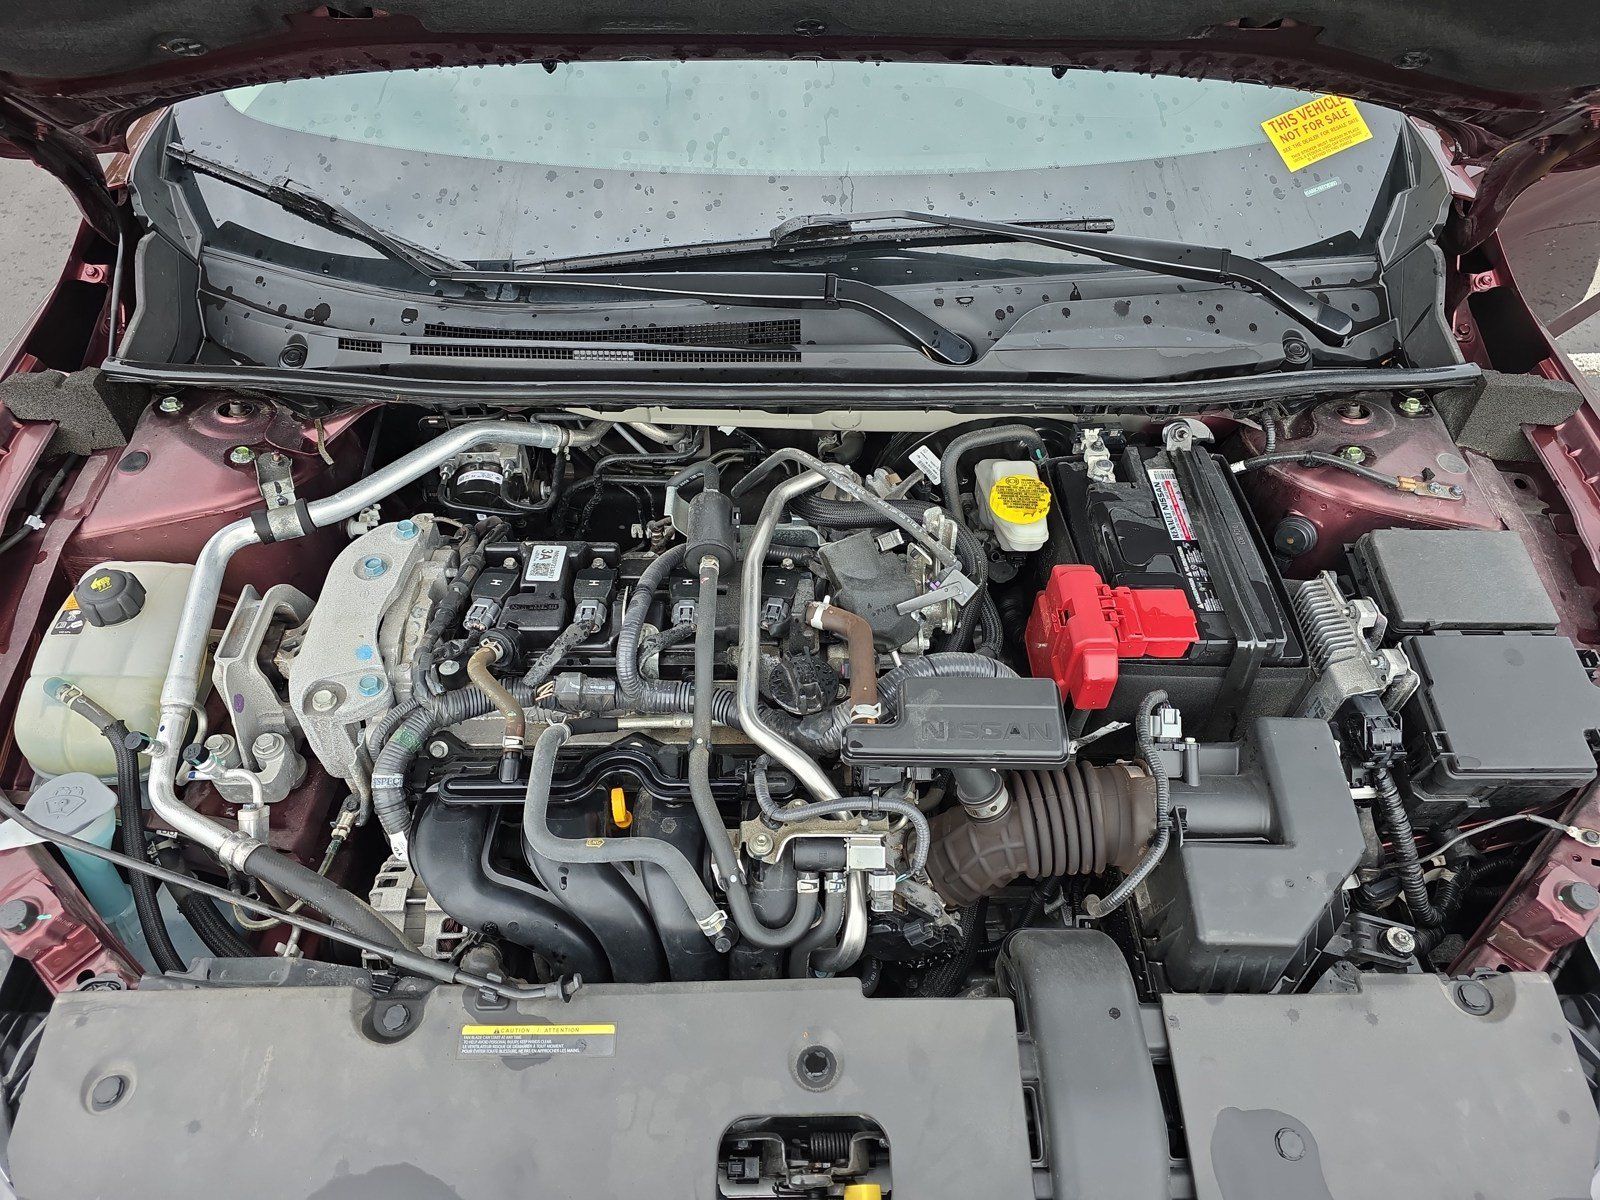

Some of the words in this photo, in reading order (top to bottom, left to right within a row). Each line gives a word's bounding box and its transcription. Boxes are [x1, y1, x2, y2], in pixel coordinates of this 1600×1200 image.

[1268, 113, 1298, 134] THIS
[1296, 96, 1347, 121] VEHICLE
[1279, 128, 1301, 144] NOT
[1302, 118, 1324, 134] FOR
[1324, 107, 1351, 124] SALE
[1302, 134, 1320, 145] DEALER
[1330, 123, 1347, 132] RESALE
[1154, 482, 1168, 510] NISSAN
[1163, 512, 1179, 538] RENAULT
[538, 549, 552, 560] 3A
[920, 720, 1052, 742] NISSAN
